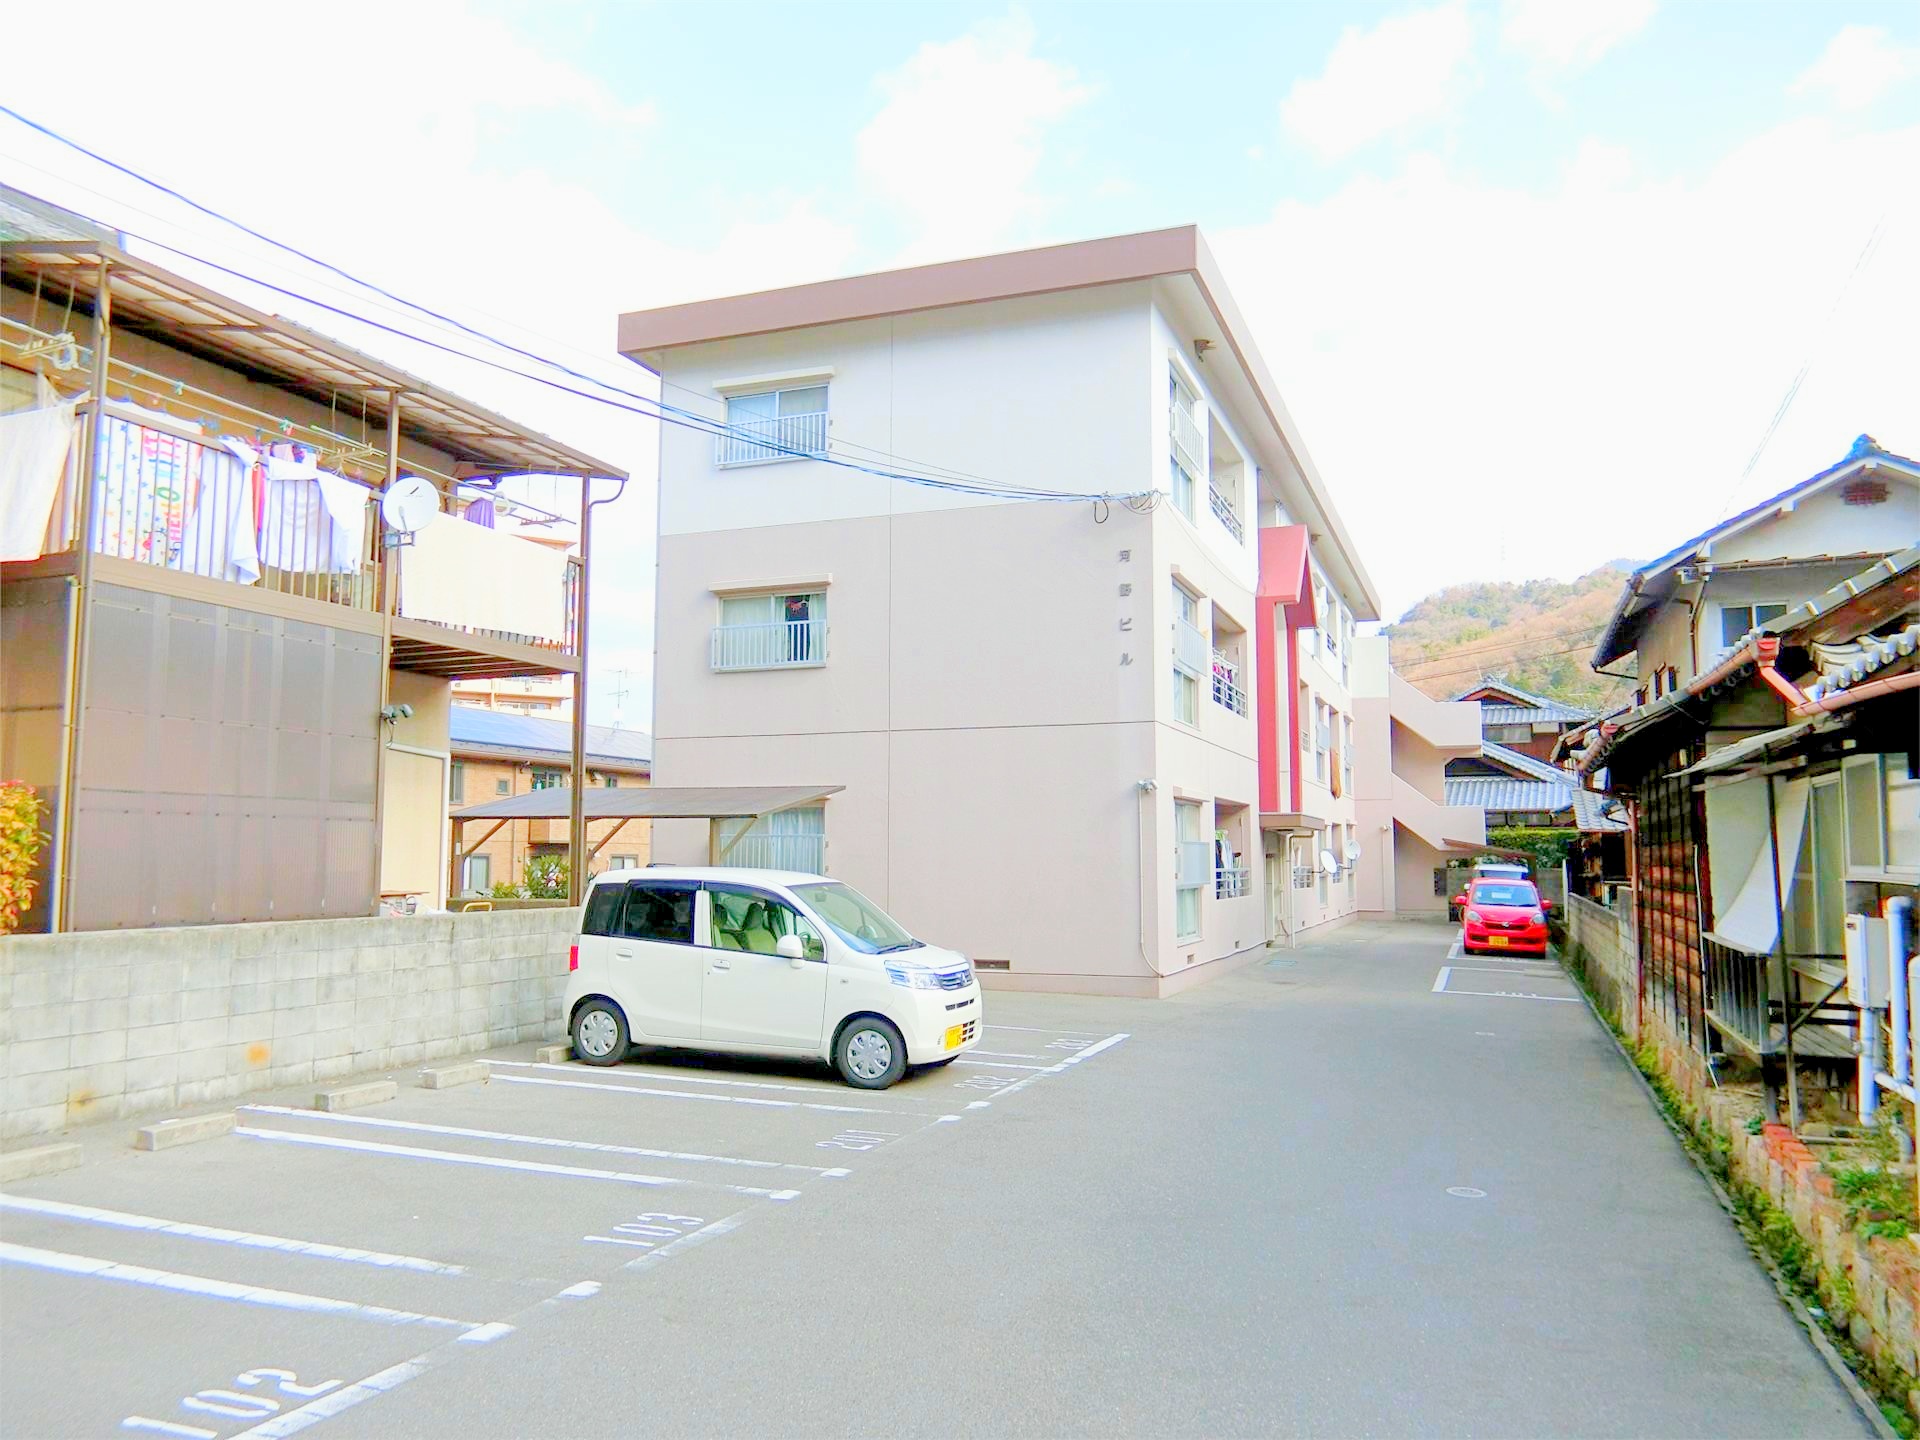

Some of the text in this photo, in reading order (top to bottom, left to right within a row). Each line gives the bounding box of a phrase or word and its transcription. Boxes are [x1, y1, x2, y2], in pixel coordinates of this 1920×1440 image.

[953, 1075, 1018, 1090] 202
[815, 1129, 899, 1150] 201
[583, 1211, 704, 1248] 103
[121, 1367, 344, 1439] 102
